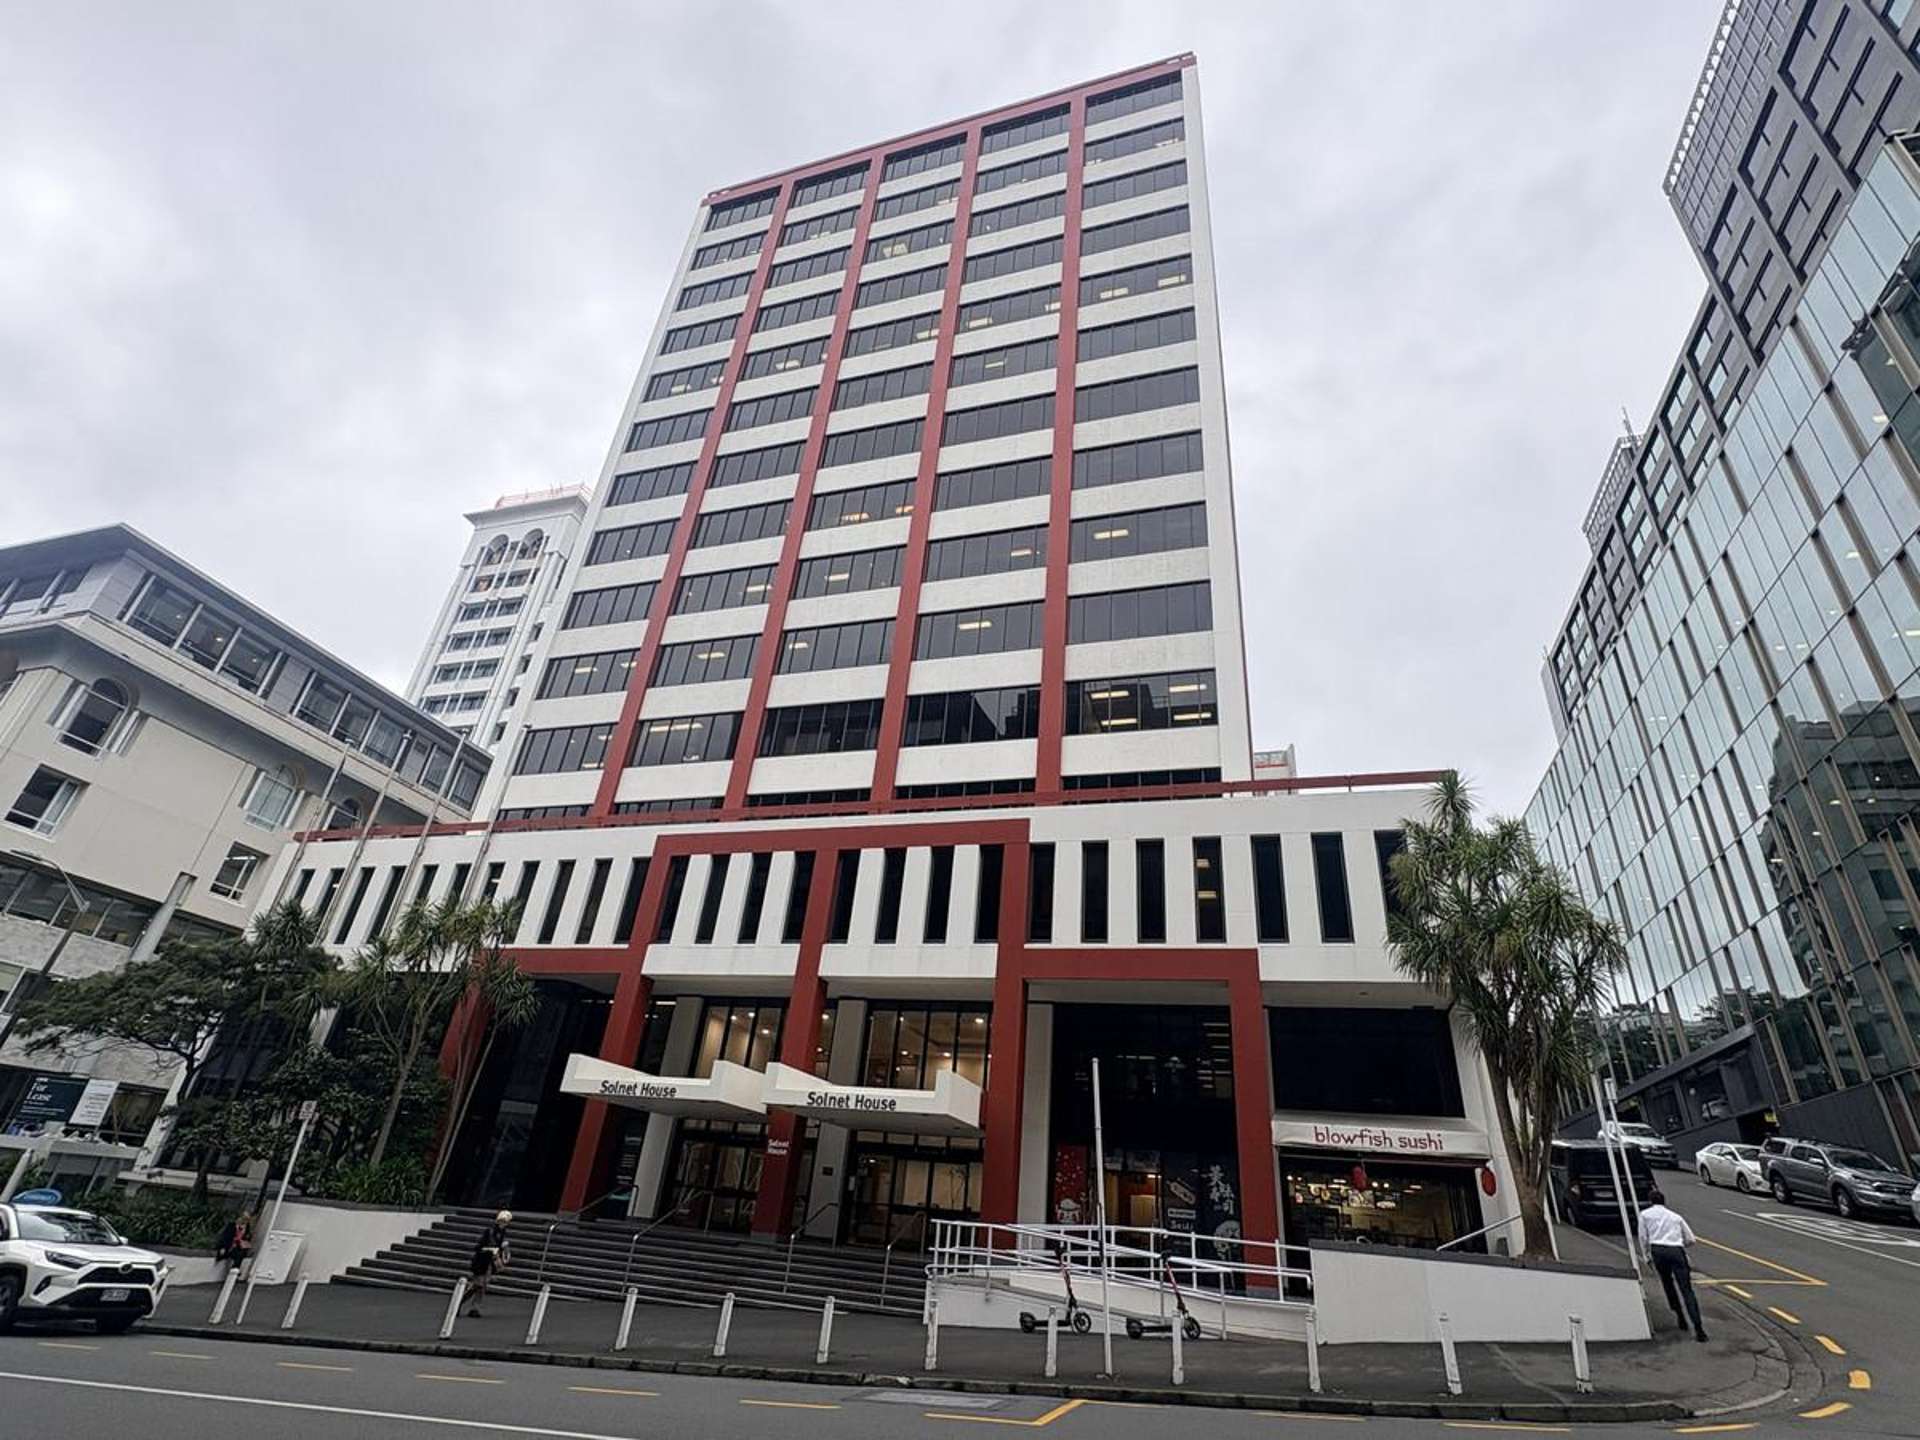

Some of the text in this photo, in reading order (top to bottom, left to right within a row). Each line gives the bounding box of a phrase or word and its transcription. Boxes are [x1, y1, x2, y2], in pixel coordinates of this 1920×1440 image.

[600, 1079, 677, 1097] Solnet House
[807, 1091, 897, 1111] Solnet House
[1313, 1125, 1443, 1150] blowfish sushi
